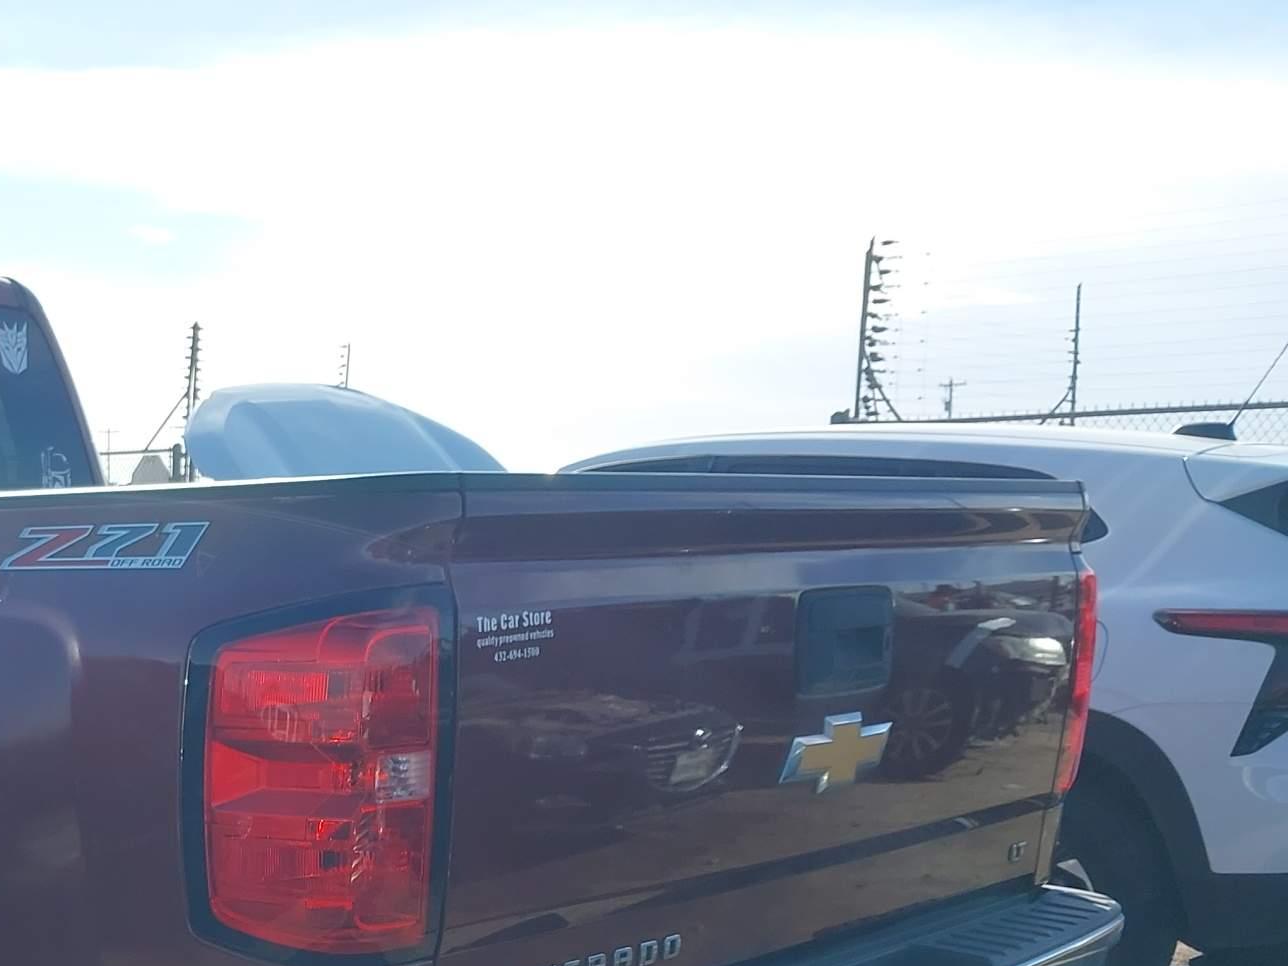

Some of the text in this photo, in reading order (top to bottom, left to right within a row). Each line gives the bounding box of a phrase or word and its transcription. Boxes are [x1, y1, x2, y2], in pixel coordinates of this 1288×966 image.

[0, 521, 210, 570] Z71
[111, 558, 183, 568] OFF ROAD
[476, 610, 552, 633] The Car Store
